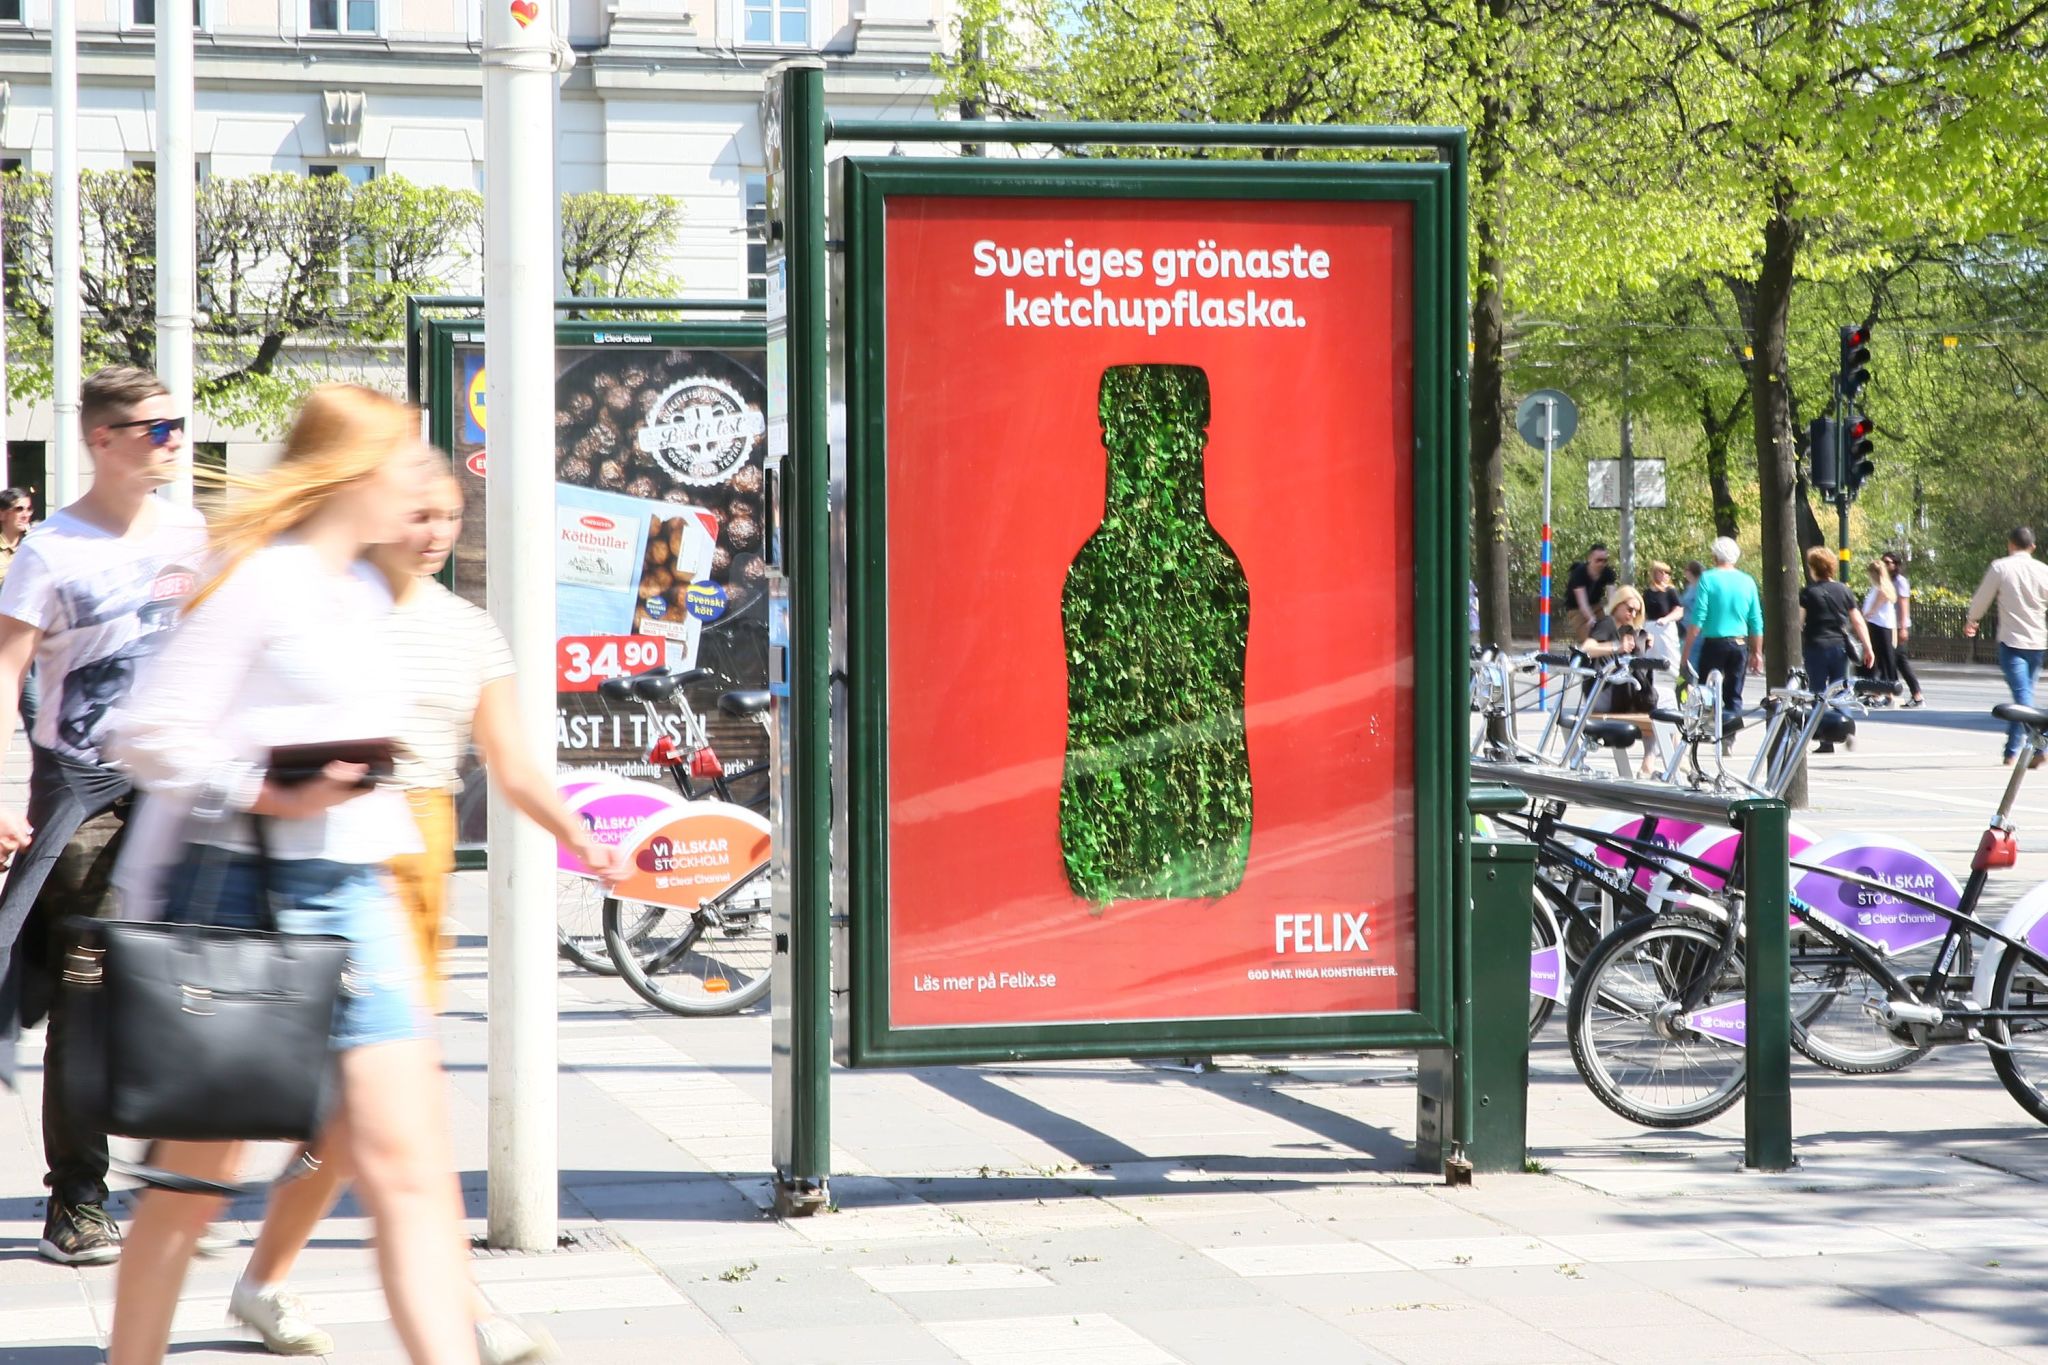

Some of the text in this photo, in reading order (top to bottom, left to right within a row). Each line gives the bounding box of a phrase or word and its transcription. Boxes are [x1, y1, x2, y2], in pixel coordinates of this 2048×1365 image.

[973, 238, 1331, 287] Sveriges grönaste
[1005, 289, 1307, 336] ketchupflaska.
[605, 333, 652, 343] Clear Channel
[717, 416, 743, 437] test
[561, 528, 629, 550] Köttbullar
[687, 593, 725, 608] Svenskt
[694, 604, 714, 616] kött
[557, 709, 604, 749] ÄST
[652, 838, 729, 857] VI ÄLSKAR
[654, 855, 730, 872] STOCKHOLM
[1574, 857, 1620, 889] CITY BIKES
[669, 873, 731, 887] Clear Channel
[1873, 913, 1936, 924] Clear Channel
[1275, 912, 1370, 954] FELIX
[913, 970, 1056, 992] Läs mer på Felix.se
[1247, 965, 1399, 980] GOD MAT. INGA KONSTIGHETER.
[1713, 1016, 1734, 1029] Clear
